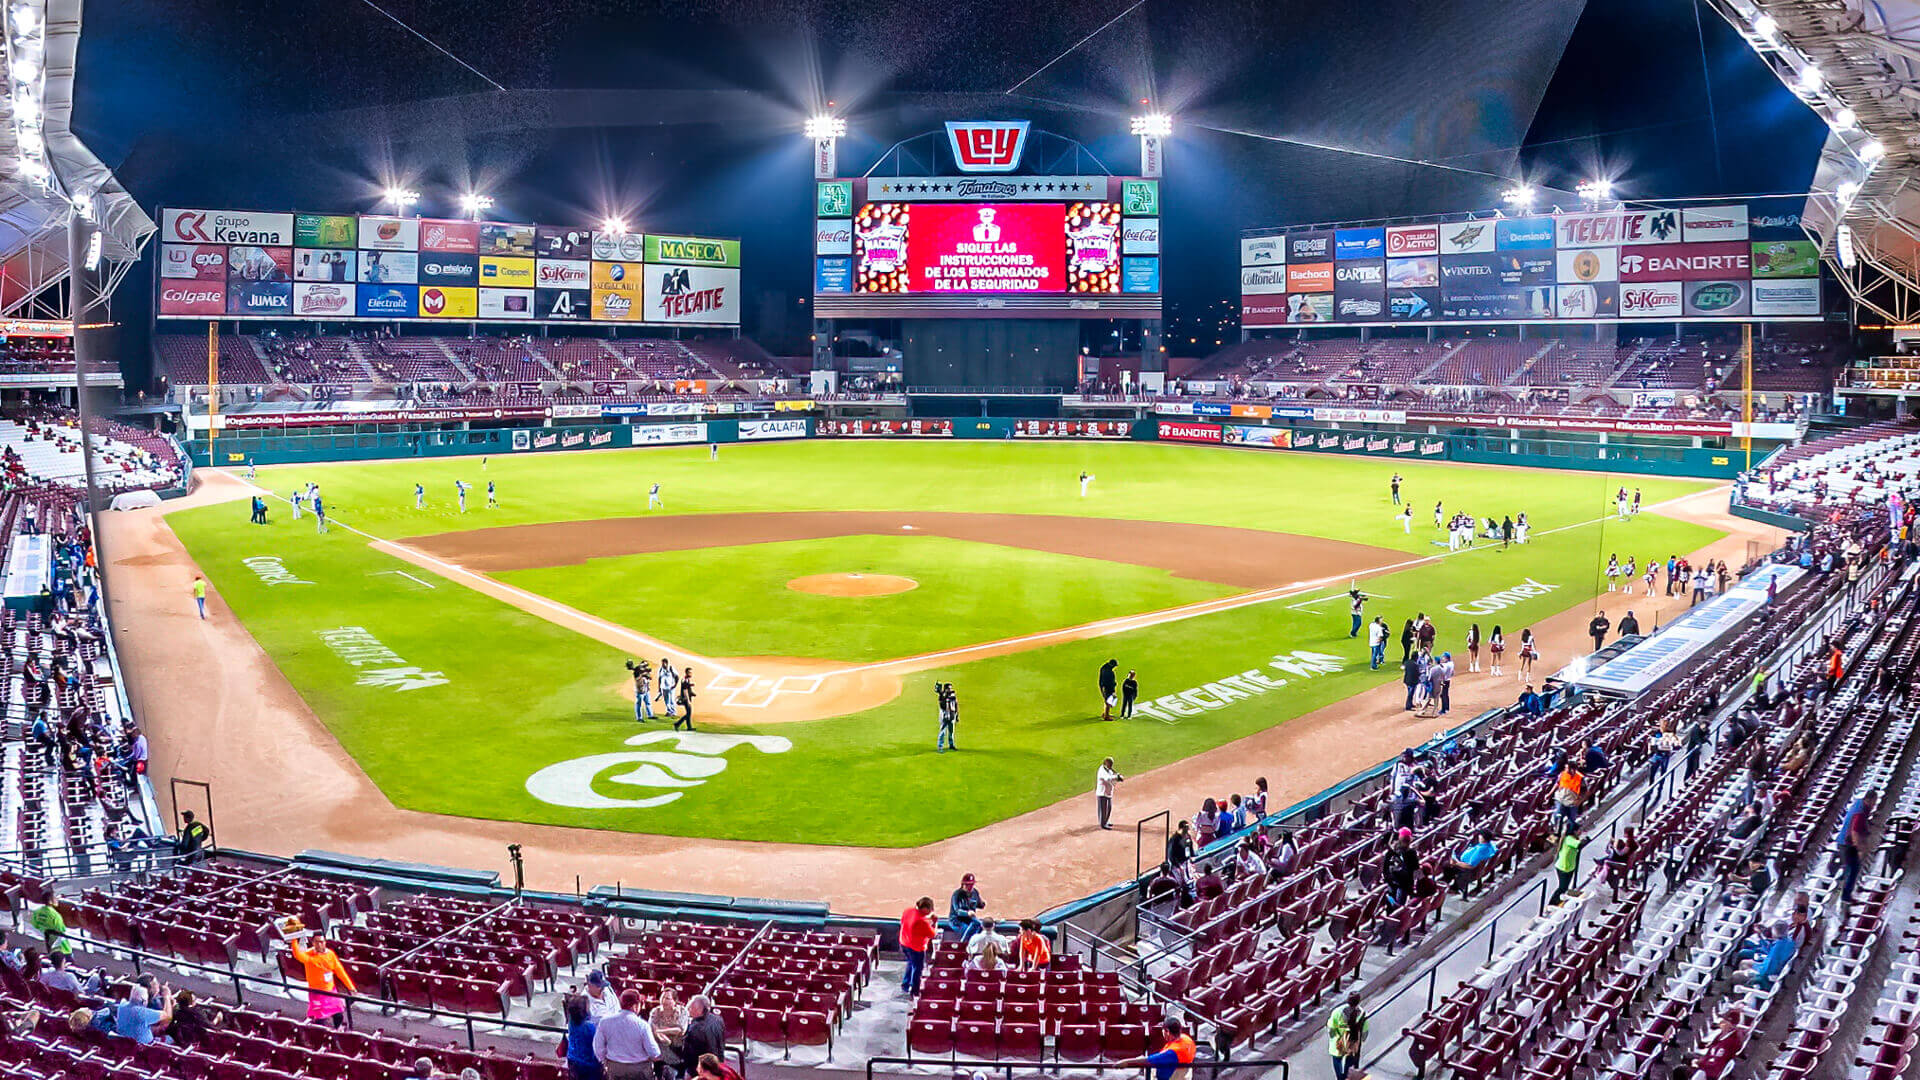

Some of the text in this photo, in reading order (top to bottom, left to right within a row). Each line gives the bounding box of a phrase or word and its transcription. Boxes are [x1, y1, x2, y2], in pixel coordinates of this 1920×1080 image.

[957, 179, 1017, 196] Tomateros
[215, 215, 250, 228] Grupo
[215, 227, 279, 244] Kevana
[1561, 214, 1647, 244] TECATE
[1406, 239, 1436, 249] ACTIVO
[1510, 232, 1552, 242] Domino's
[661, 240, 726, 262] MASECA
[994, 243, 1017, 253] LAS
[940, 254, 1034, 266] INSTRUCCIONES
[1648, 254, 1749, 272] BANORTE
[539, 265, 586, 284] SuKarne
[925, 267, 1049, 278] DE LOS ENCARGADOS
[1290, 270, 1330, 280] Bachoco
[1451, 265, 1492, 276] VINOTECA
[935, 279, 1039, 290] DE LA SEGURIDAD
[163, 289, 221, 305] Colgate
[247, 293, 288, 307] JUMEX
[660, 287, 724, 319] TECATE
[1623, 289, 1678, 310] SuKarne
[761, 421, 806, 433] CALAFIA
[1172, 426, 1220, 439] BANORTE
[1445, 577, 1560, 615] Comex
[1131, 668, 1287, 725] TECATE
